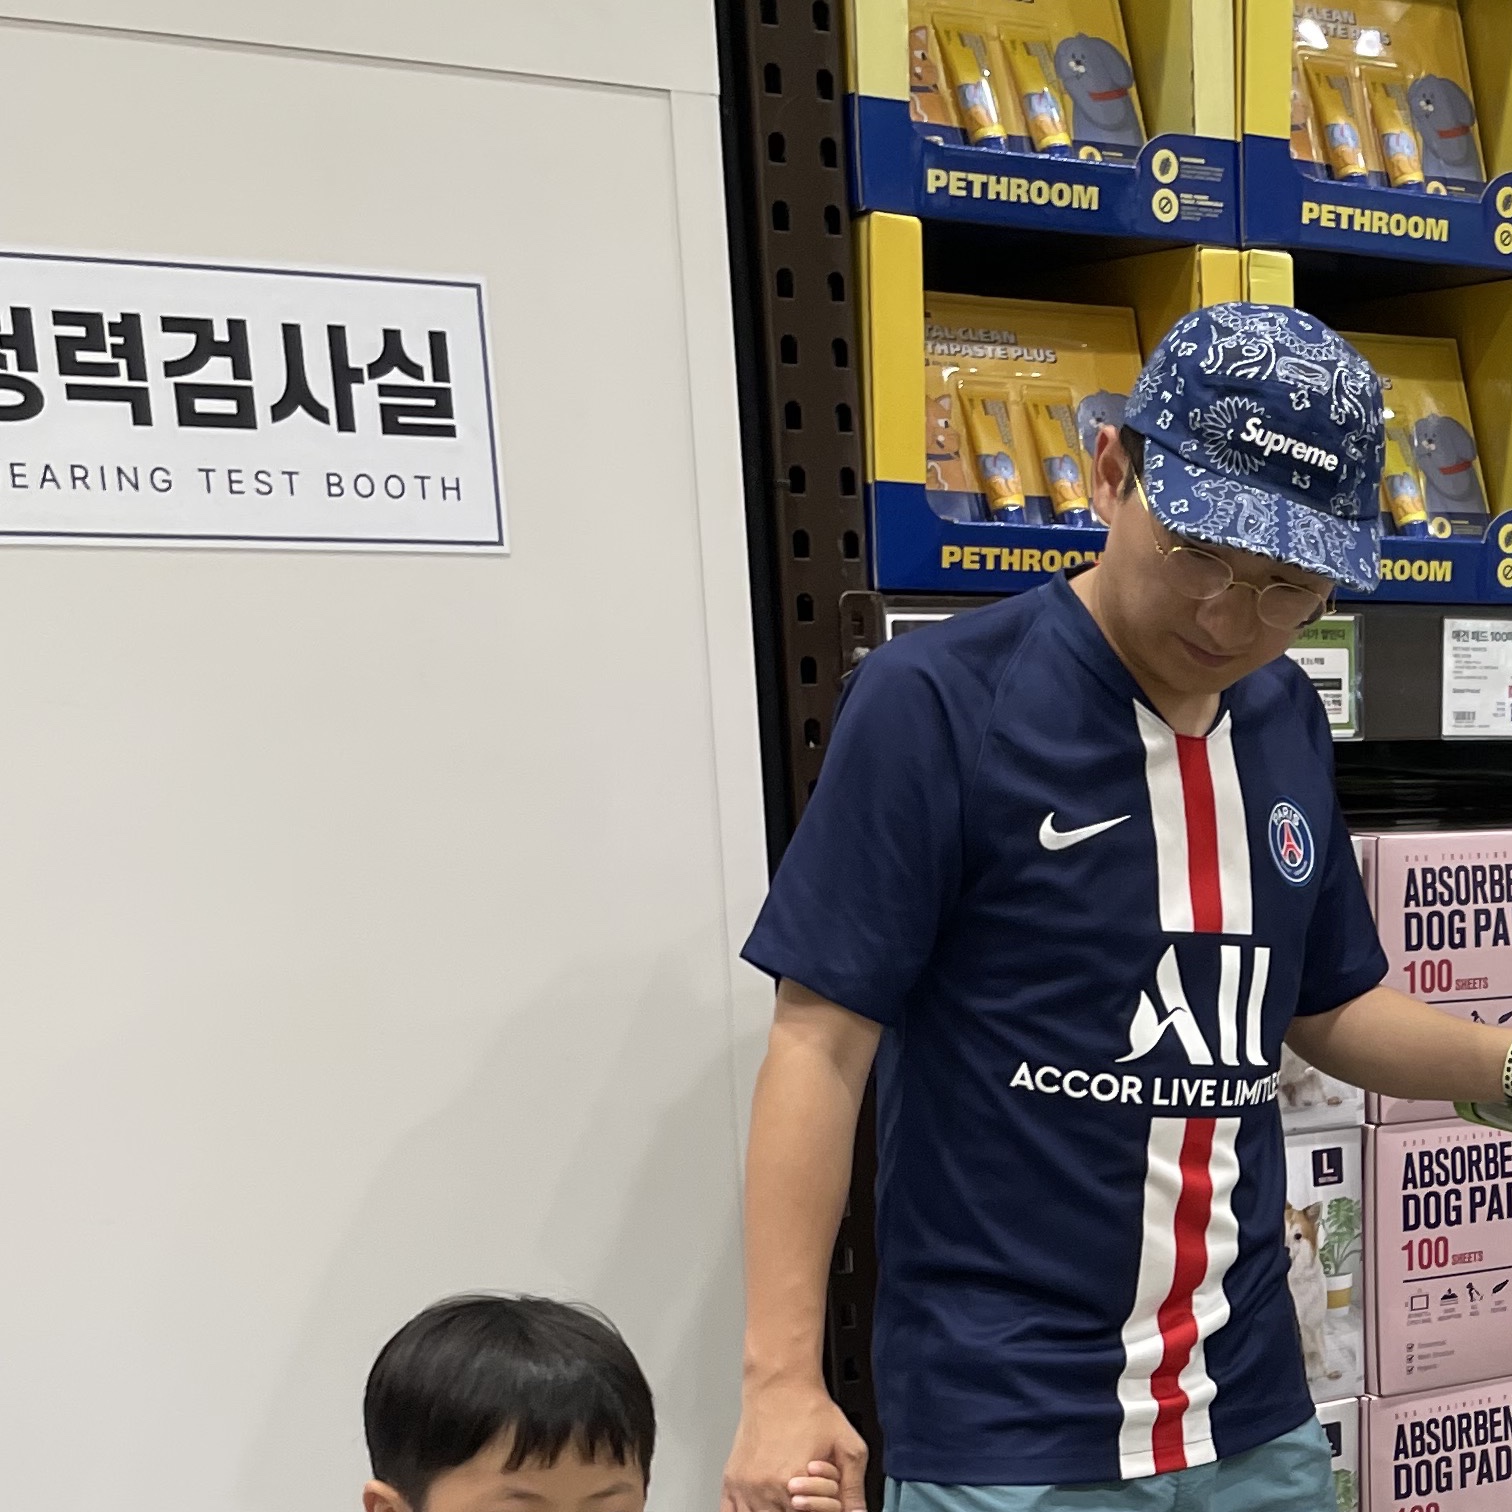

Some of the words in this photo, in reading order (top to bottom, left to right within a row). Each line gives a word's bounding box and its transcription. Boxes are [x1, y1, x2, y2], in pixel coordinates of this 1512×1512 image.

[926, 168, 1100, 211] PETHROOM
[1301, 202, 1449, 243] PETHROOM
[1012, 347, 1057, 364] PLUS
[1240, 417, 1339, 473] Supreme
[10, 462, 174, 493] EARING
[198, 467, 300, 497] TEST
[326, 472, 462, 501] BOOTH
[1381, 557, 1453, 582] ROOM
[1404, 910, 1473, 952] DOG
[1403, 959, 1453, 994] 100
[1455, 976, 1489, 991] SHEETS
[1010, 1061, 1143, 1105] ACCOR
[1153, 1077, 1217, 1106] LIVE
[1221, 1073, 1280, 1107] LIMITE
[1322, 1152, 1335, 1174] L
[1402, 1191, 1462, 1232] DOG
[1401, 1236, 1449, 1272] 100
[1451, 1250, 1484, 1266] SHEETS
[1394, 1455, 1453, 1500] DOG
